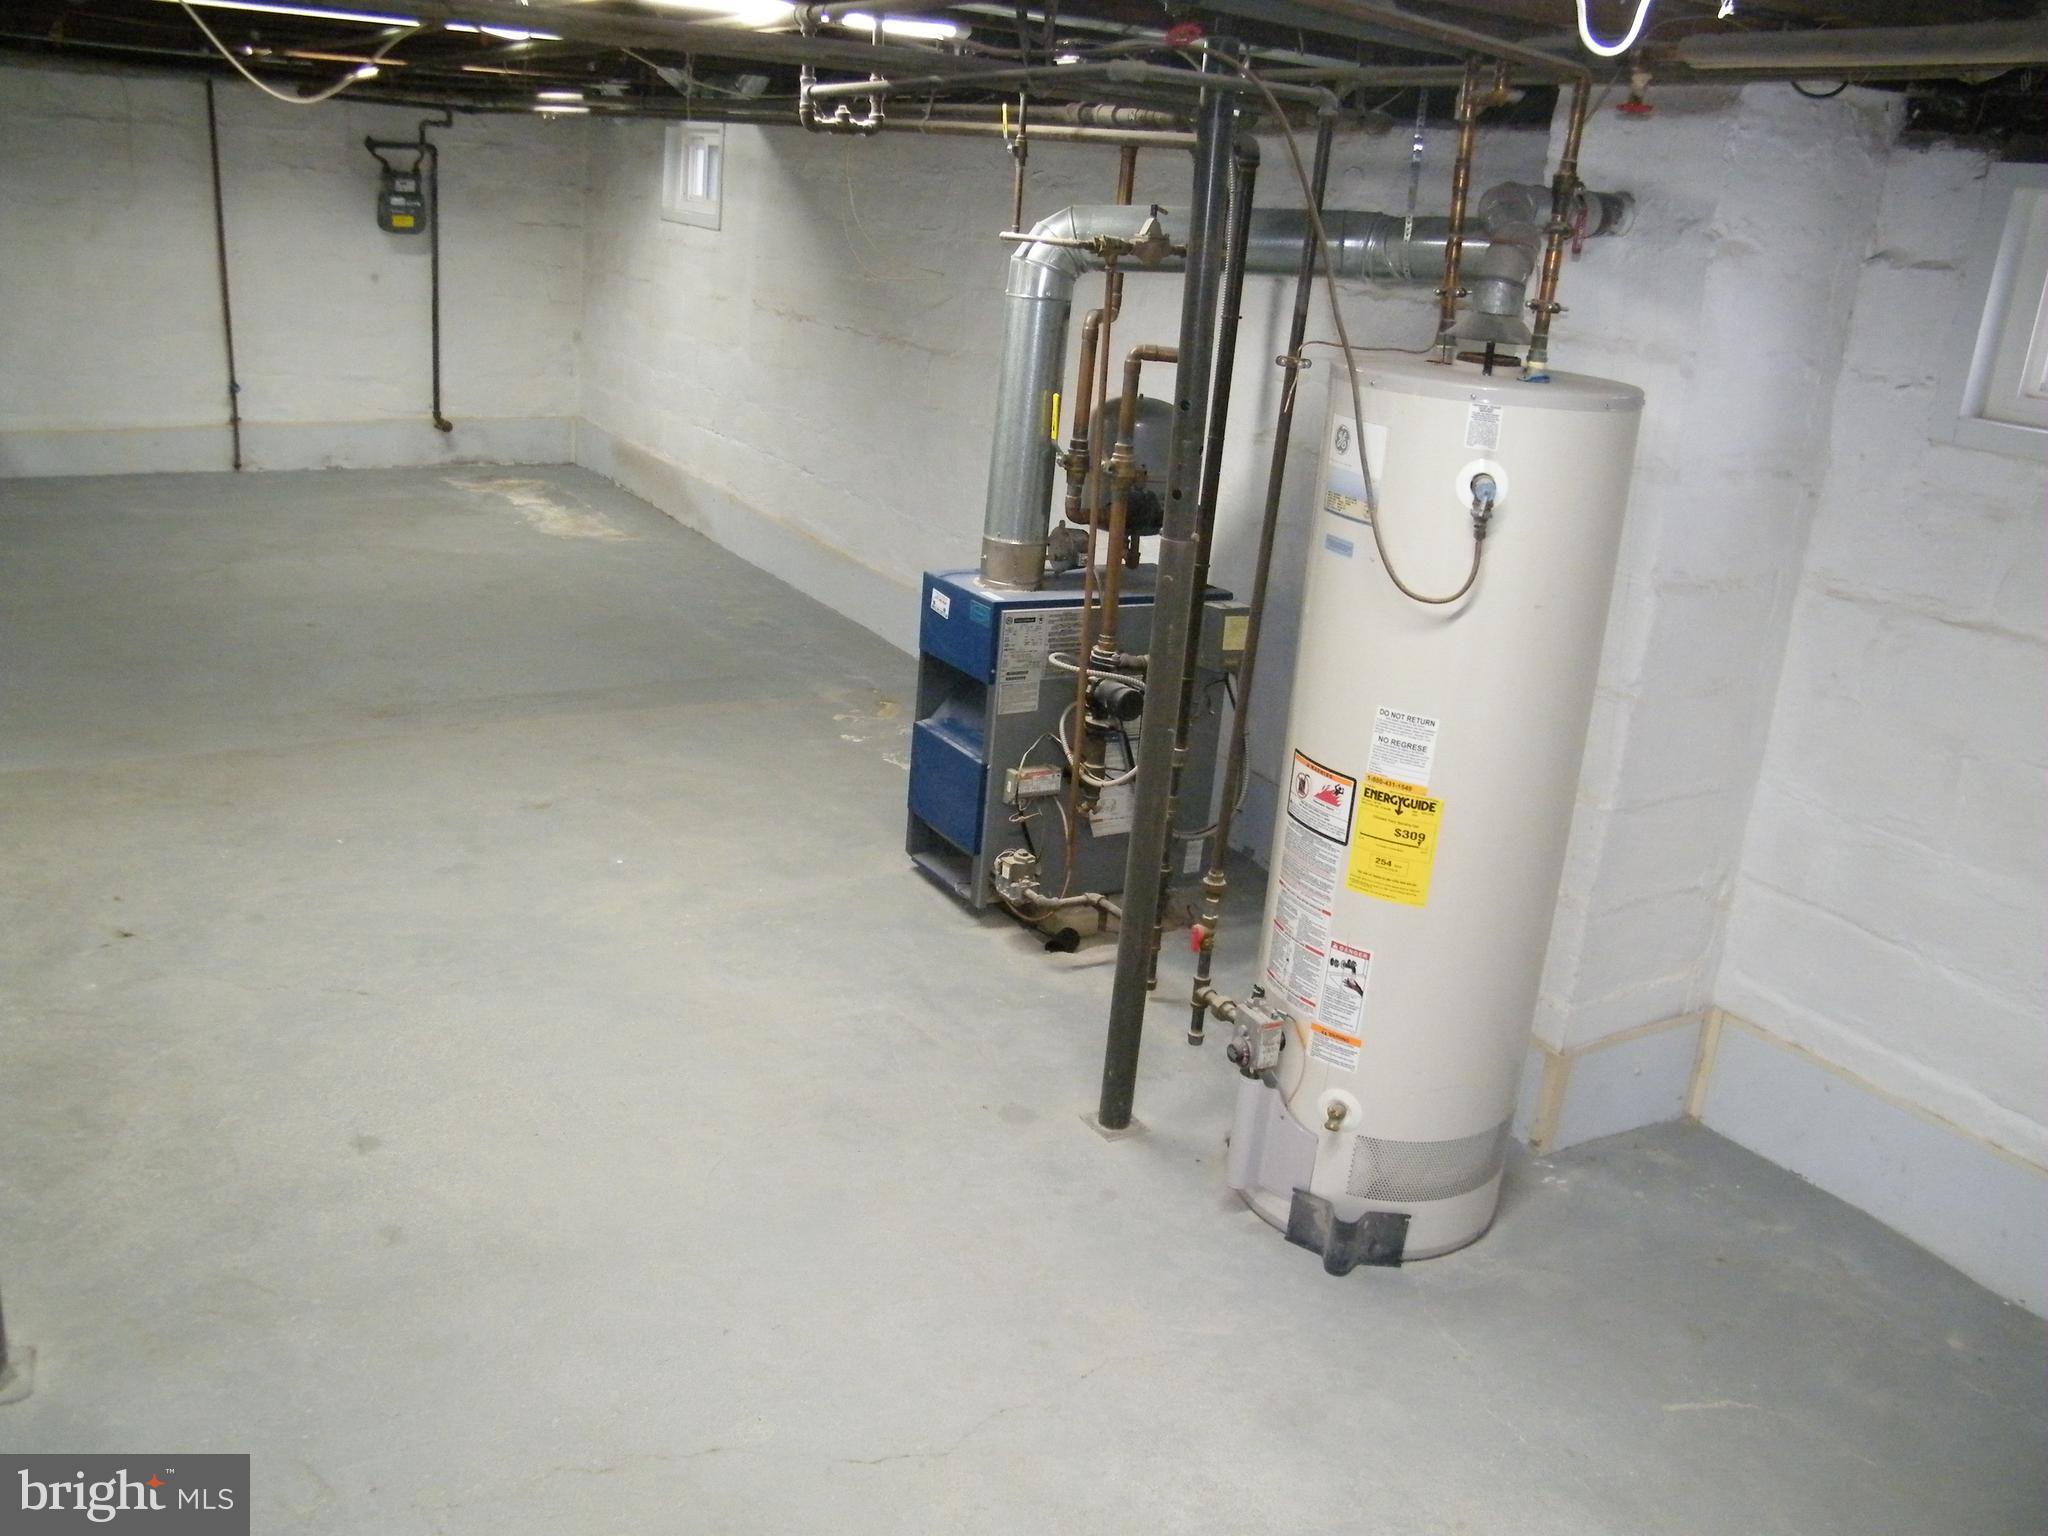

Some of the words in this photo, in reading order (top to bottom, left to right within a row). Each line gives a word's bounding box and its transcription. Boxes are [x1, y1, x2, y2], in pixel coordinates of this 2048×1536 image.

[1379, 708, 1390, 717] DO
[1391, 711, 1406, 720] NOT
[1406, 715, 1436, 727] RETURN
[1377, 735, 1390, 744] NO
[1390, 738, 1428, 753] REGRESE
[1394, 828, 1426, 843] $309
[1375, 857, 1392, 867] 254
